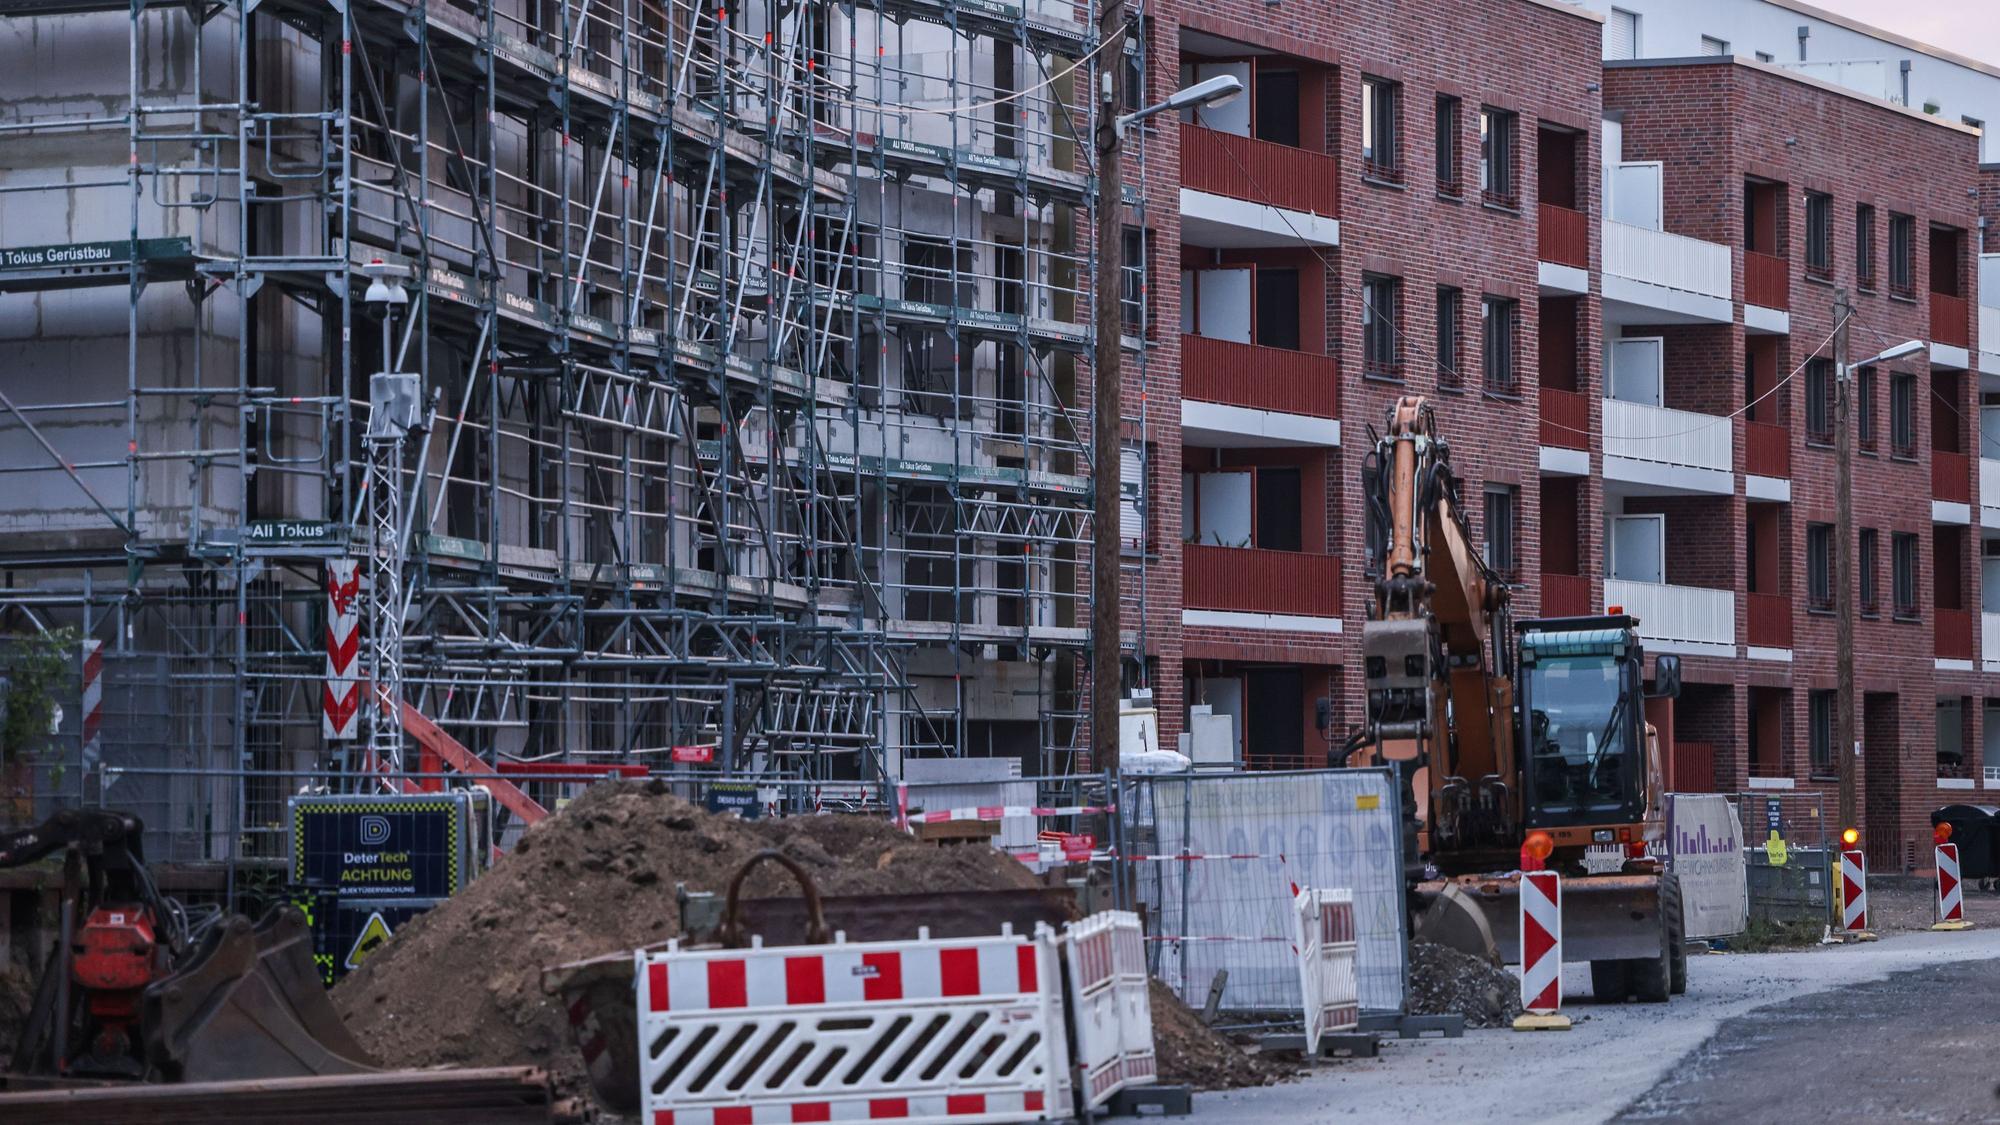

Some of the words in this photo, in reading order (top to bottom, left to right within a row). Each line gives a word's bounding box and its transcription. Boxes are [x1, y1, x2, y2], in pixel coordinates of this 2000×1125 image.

[893, 141, 901, 150] ALI
[901, 142, 915, 152] TOKUS
[6, 251, 44, 265] Tokus
[46, 246, 111, 262] Gerüstbau
[828, 454, 839, 463] Tokus
[905, 462, 915, 470] Tokus
[915, 462, 932, 471] Gerüstbau
[252, 524, 273, 538] Ali
[277, 524, 324, 538] Tokus
[341, 869, 413, 882] ACHTUNG
